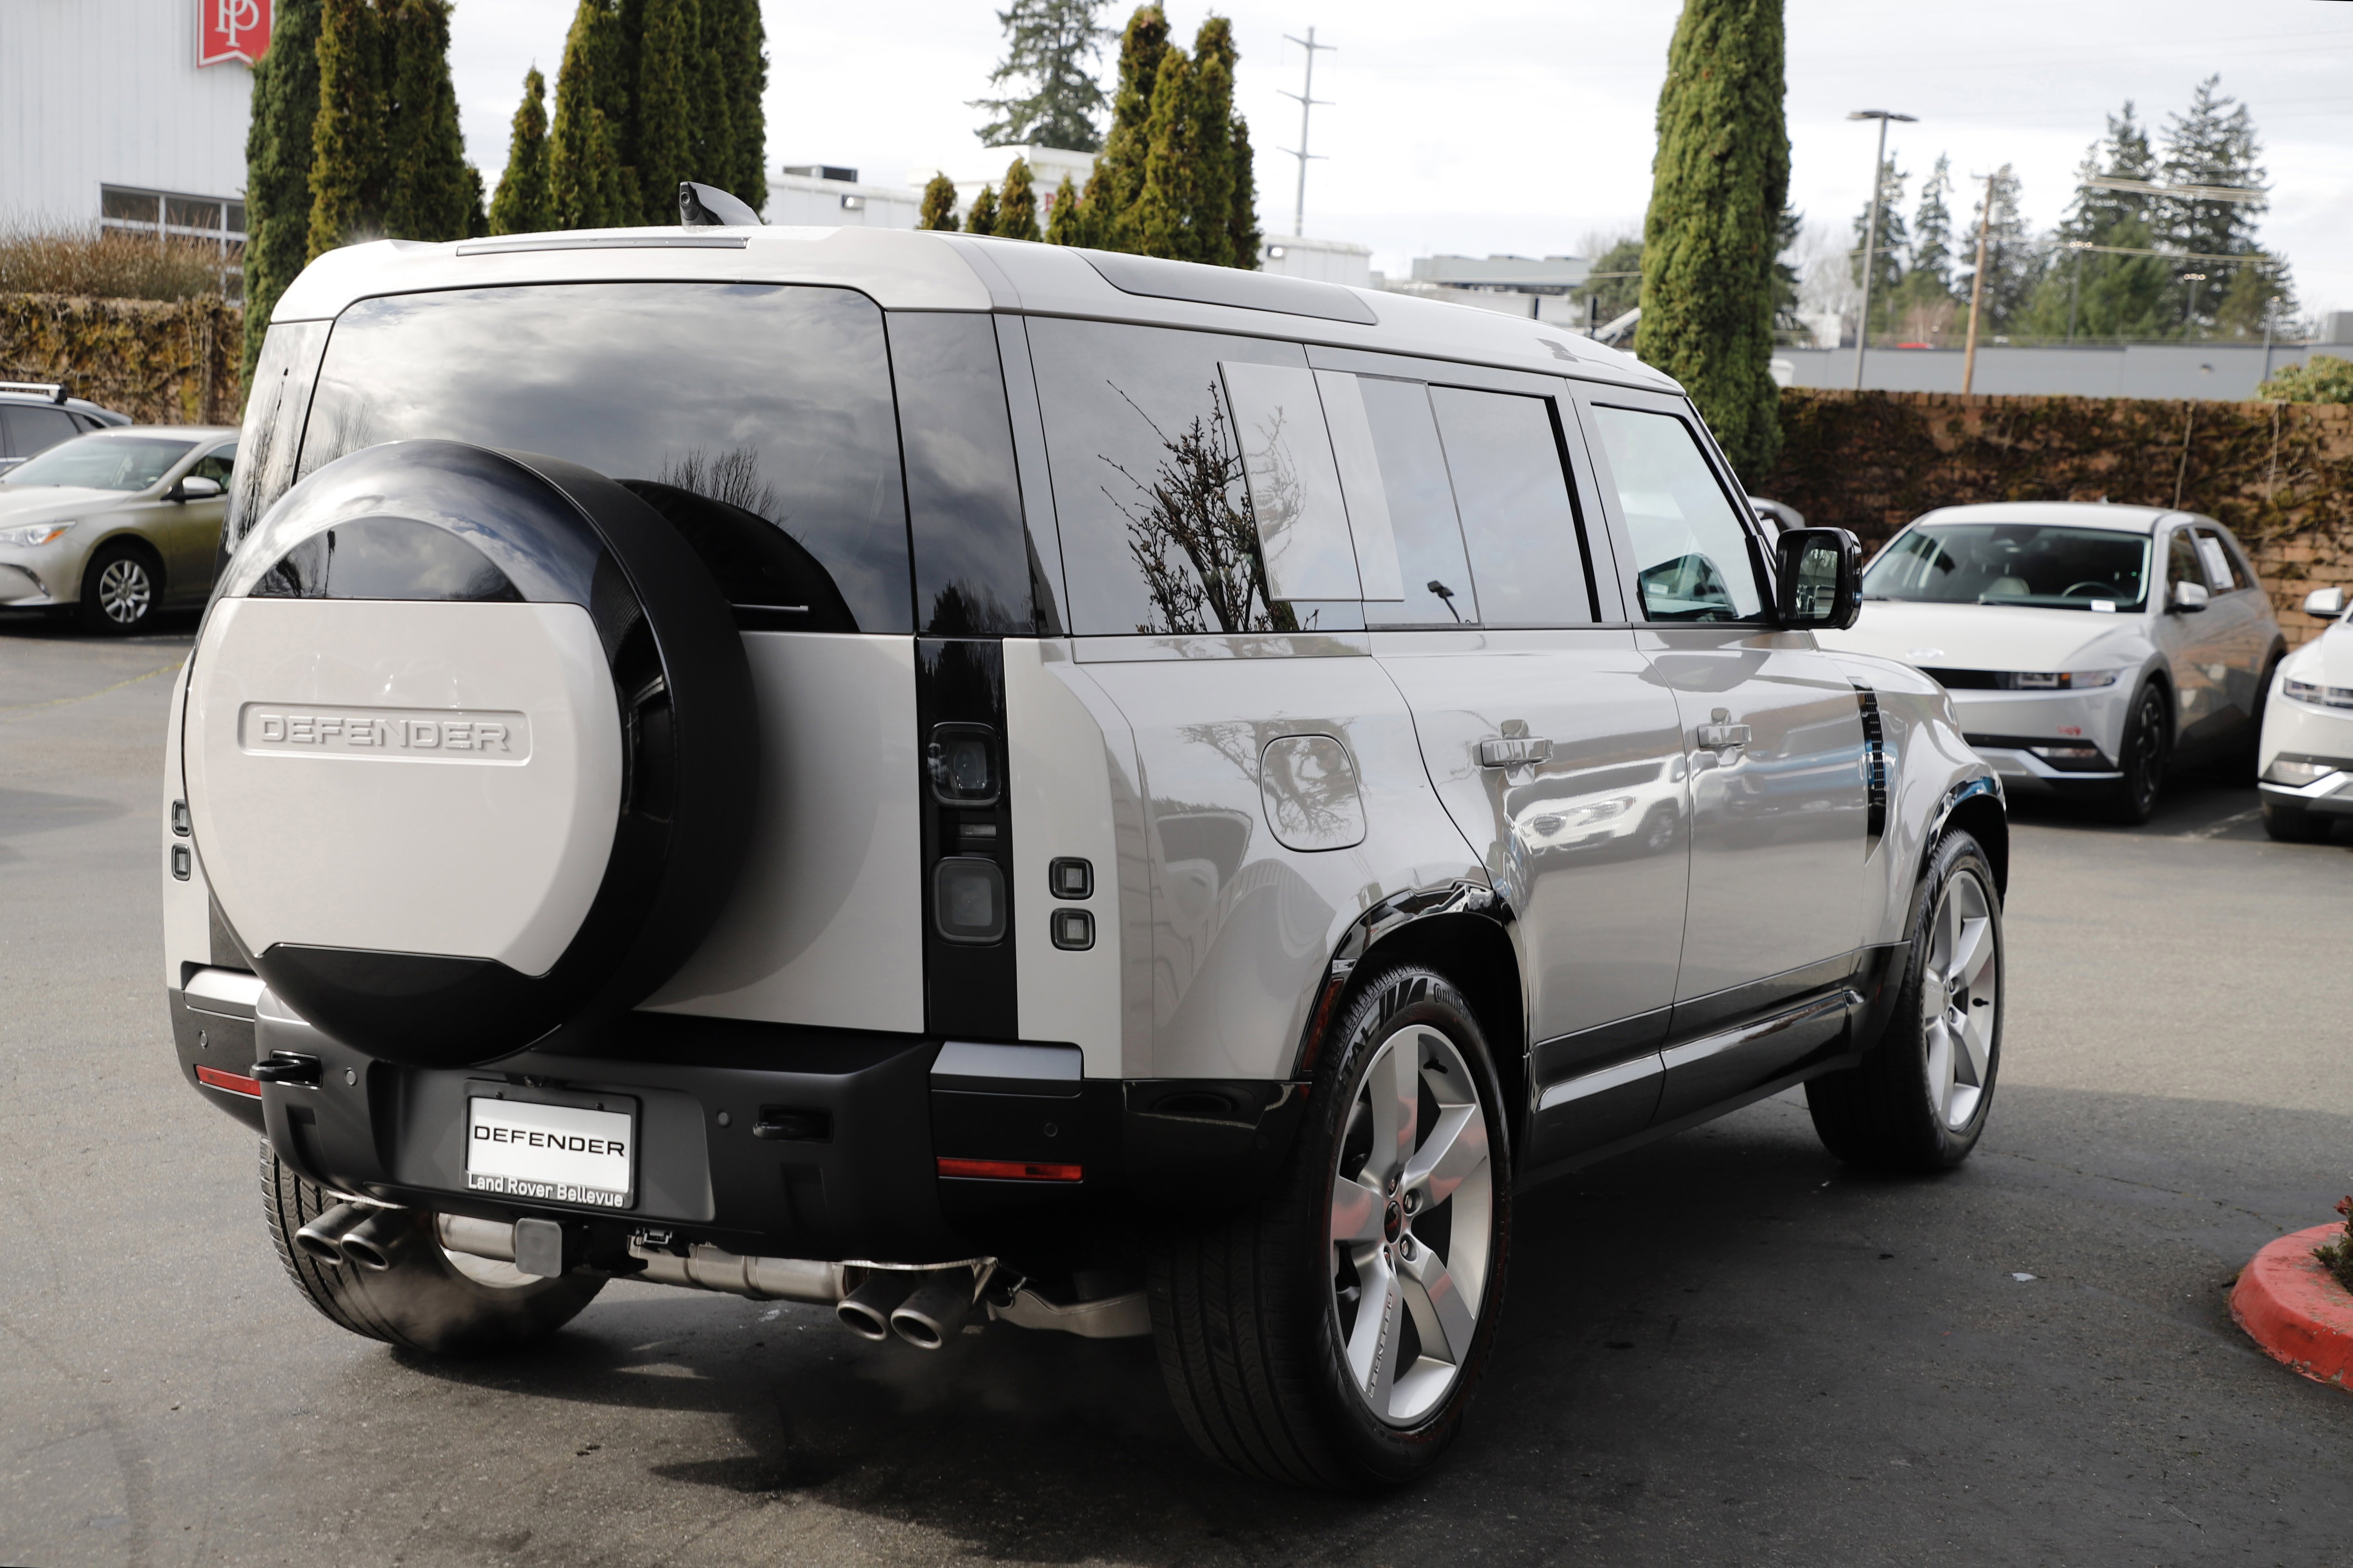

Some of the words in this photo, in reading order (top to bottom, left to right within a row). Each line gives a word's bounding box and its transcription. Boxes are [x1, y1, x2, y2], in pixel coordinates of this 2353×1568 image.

[259, 714, 510, 751] DEFENDER
[474, 1125, 625, 1157] DEFENDER
[468, 1172, 504, 1193] Land
[507, 1177, 554, 1198] Rover
[557, 1183, 624, 1208] Bellevue
